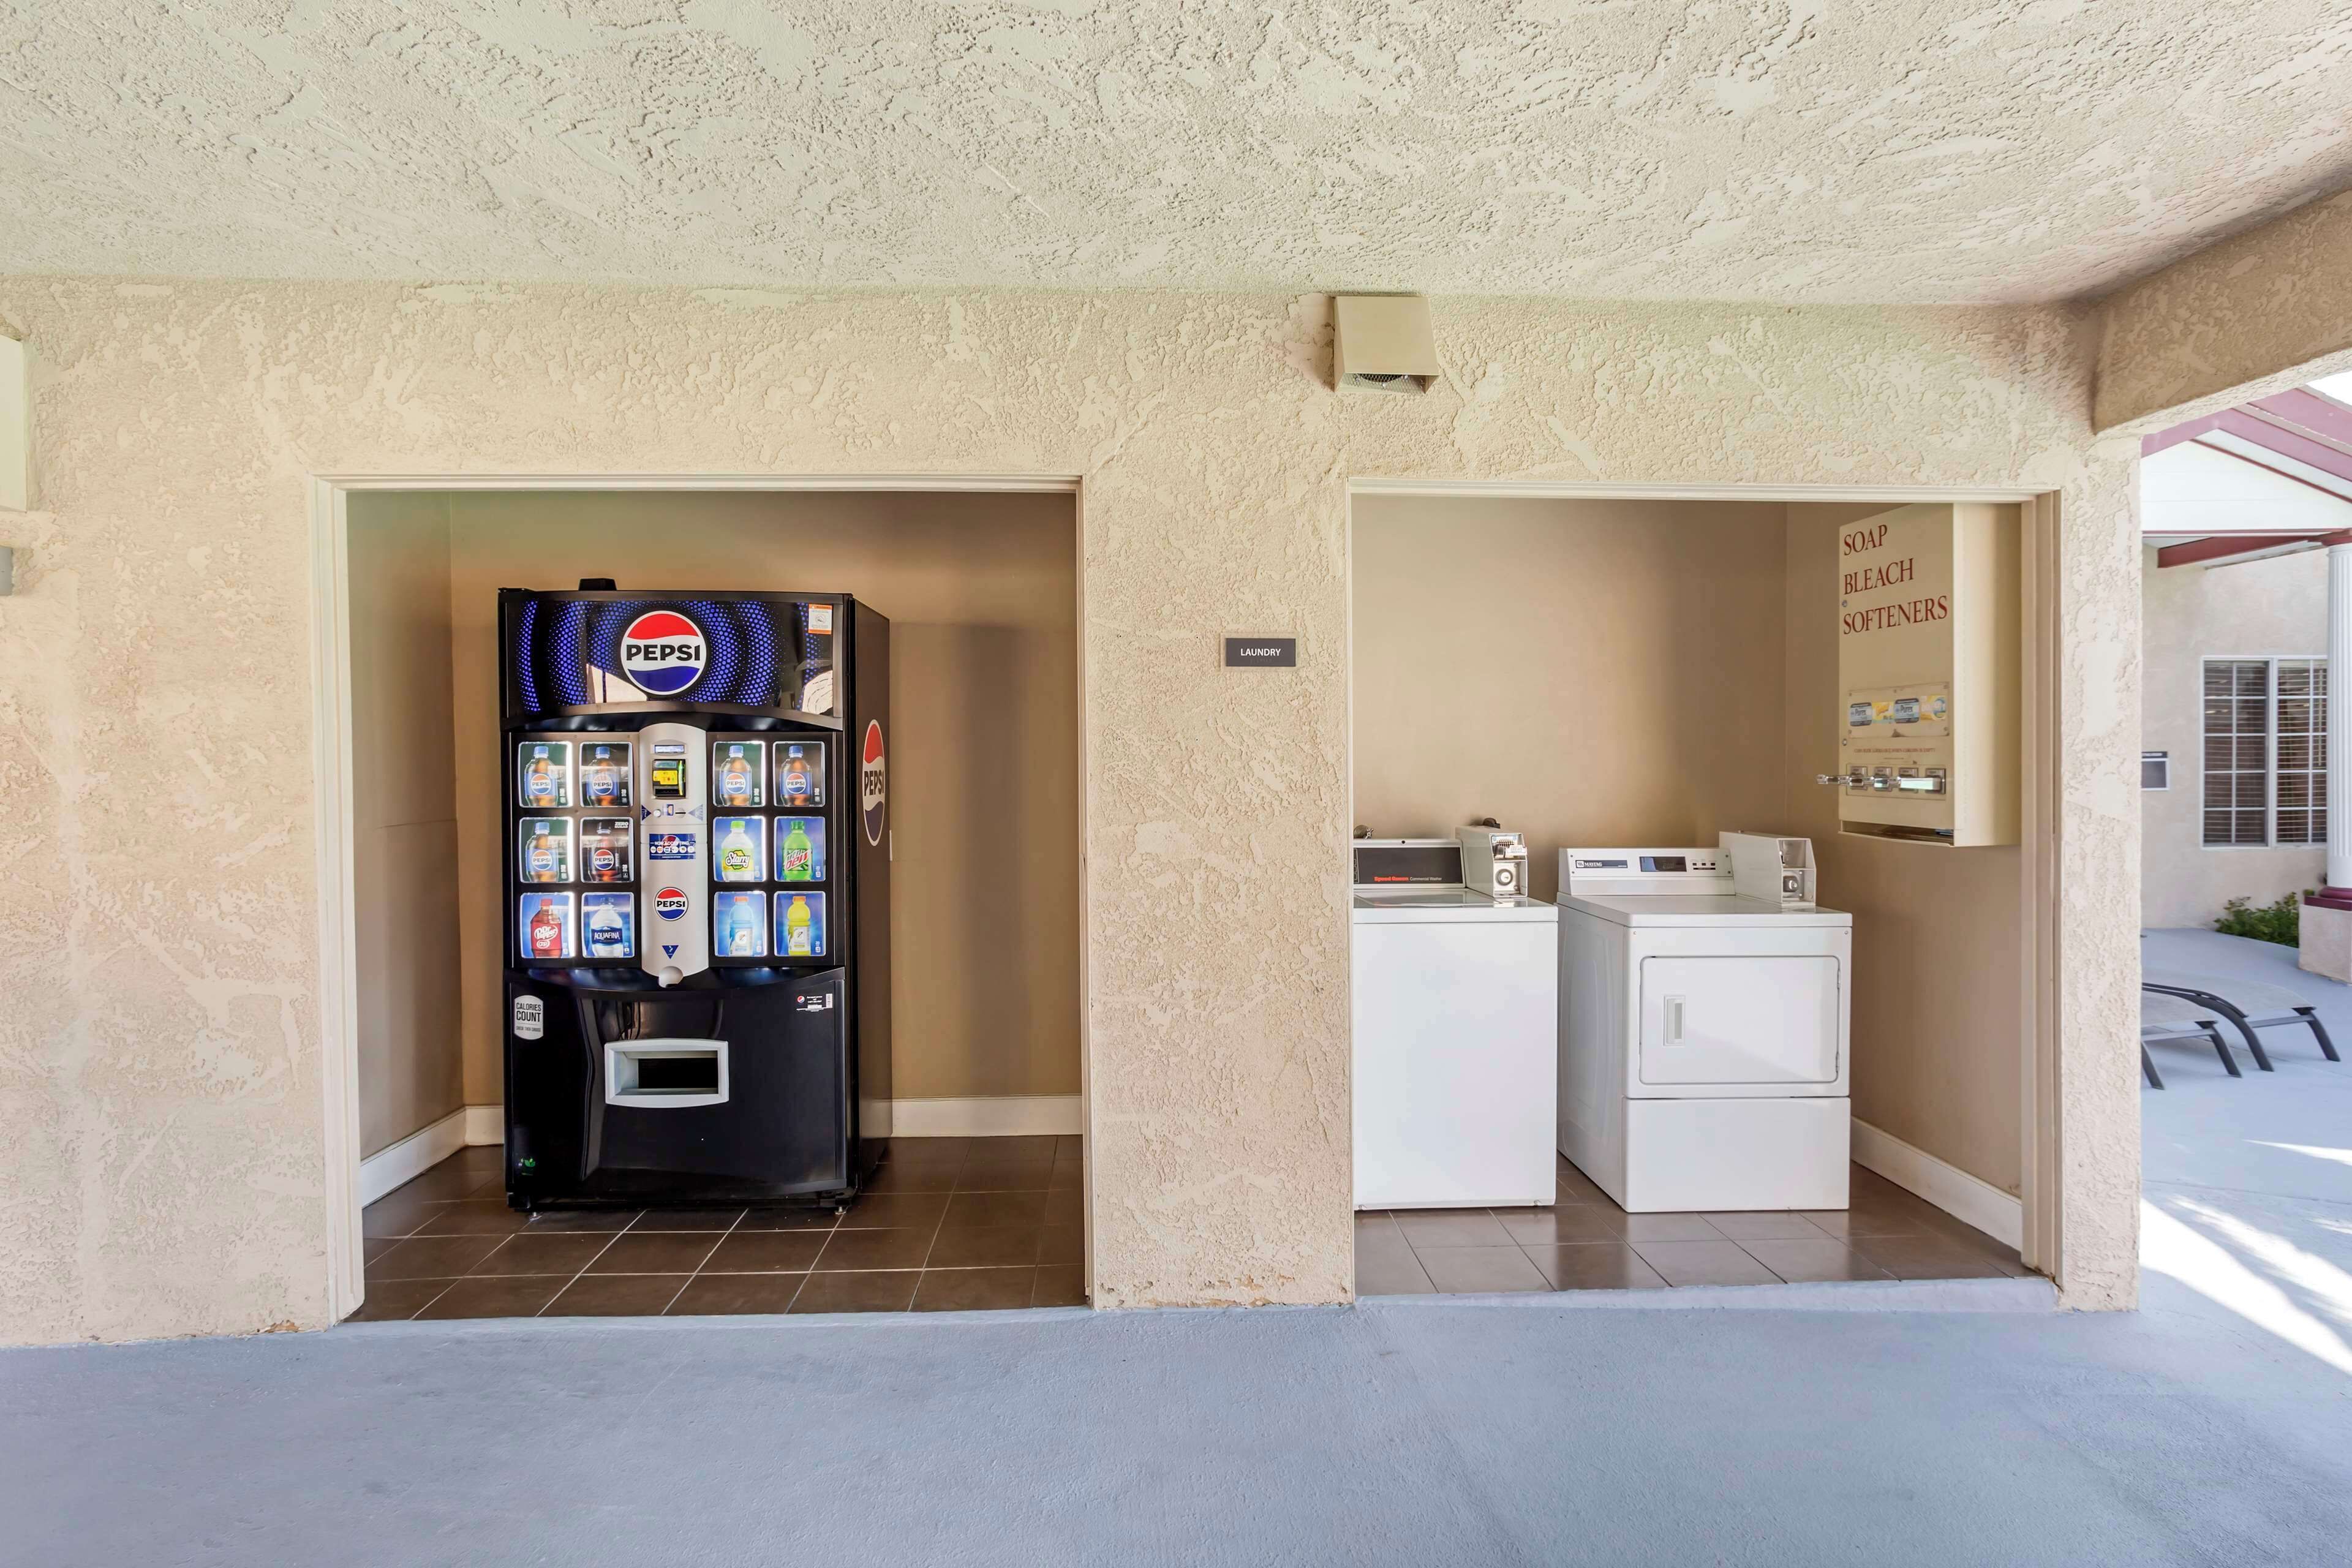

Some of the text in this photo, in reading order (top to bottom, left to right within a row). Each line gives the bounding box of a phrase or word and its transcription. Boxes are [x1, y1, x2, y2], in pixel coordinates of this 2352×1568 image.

[1844, 524, 1887, 556] SOAP
[1844, 557, 1913, 595] BLEACH
[1843, 595, 1948, 635] SOFTENERS
[626, 644, 701, 662] PEPSI
[864, 769, 884, 797] PEPSI
[594, 931, 620, 941] AQUAFINA
[516, 1003, 541, 1011] CALORIES
[516, 1011, 541, 1022] COUNT
